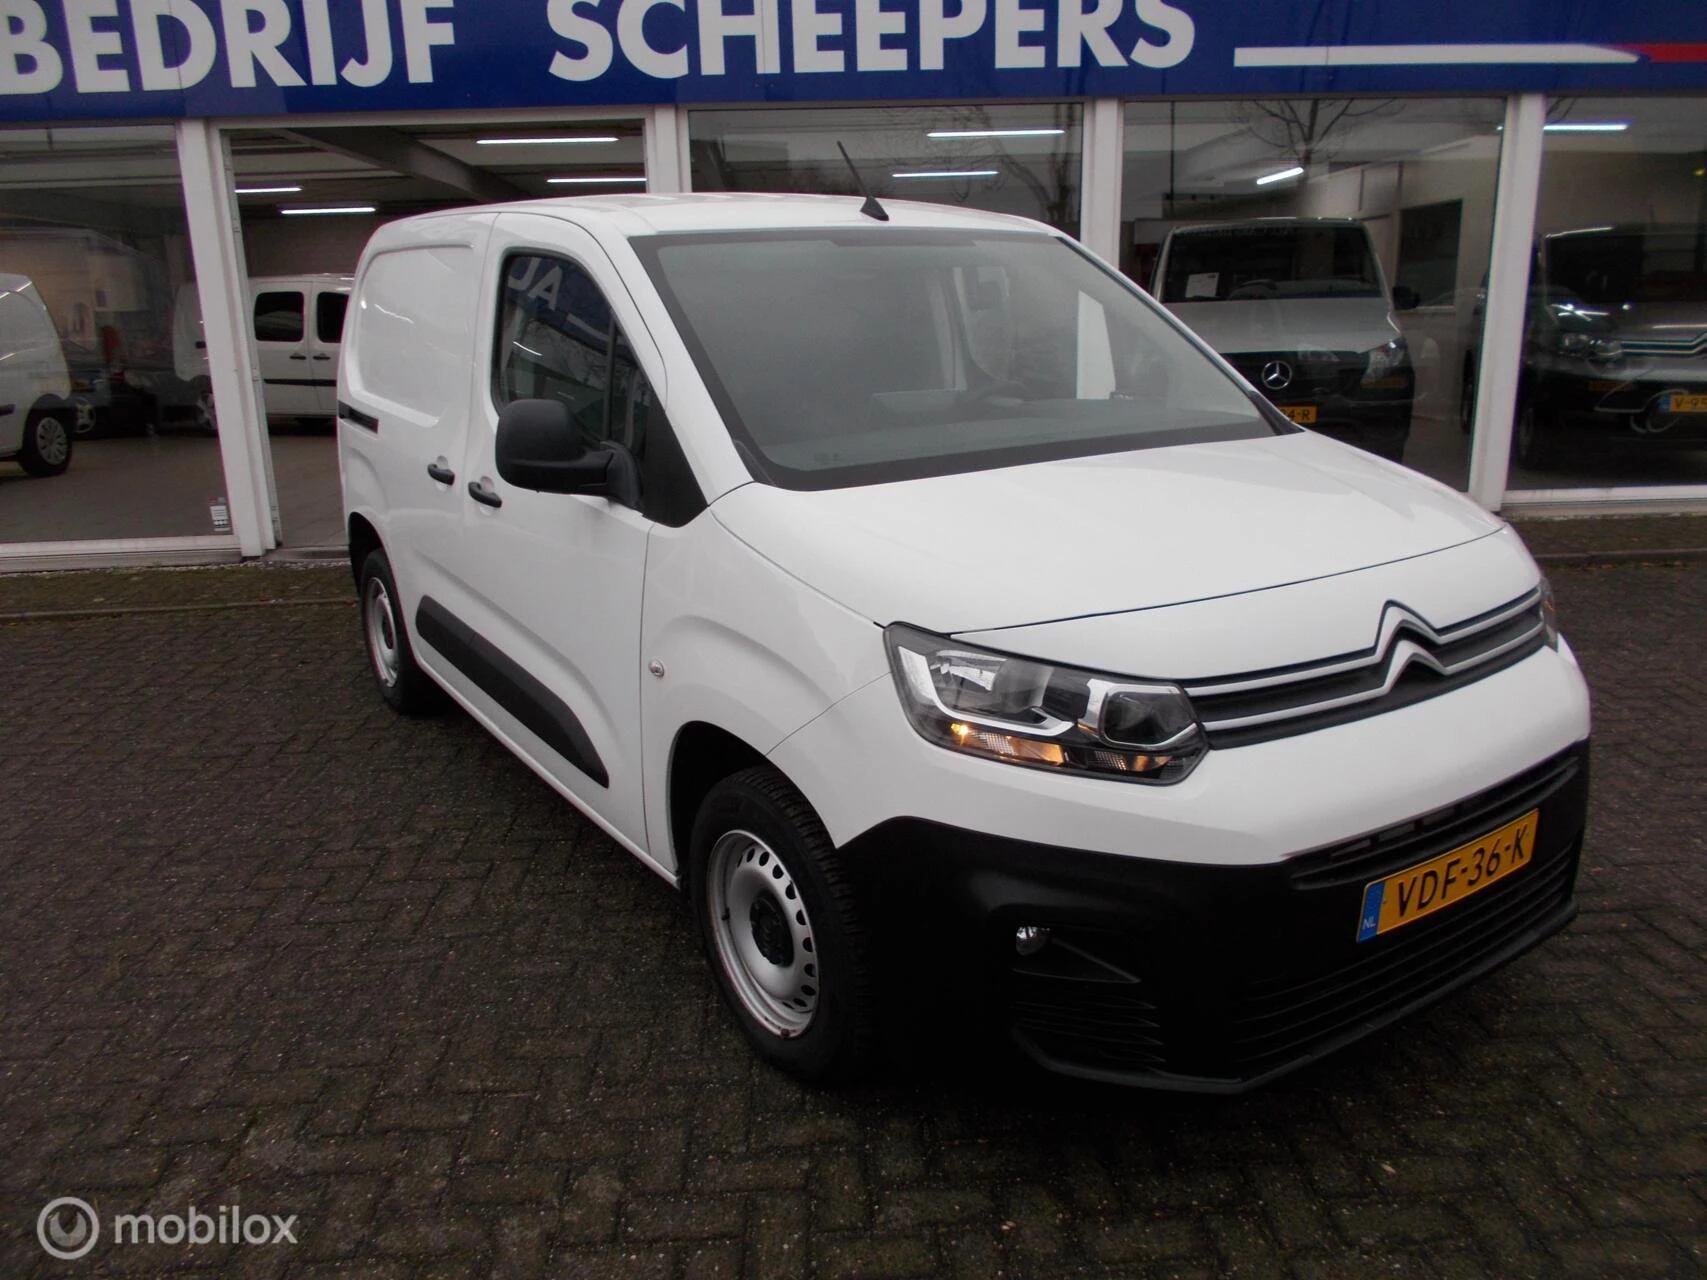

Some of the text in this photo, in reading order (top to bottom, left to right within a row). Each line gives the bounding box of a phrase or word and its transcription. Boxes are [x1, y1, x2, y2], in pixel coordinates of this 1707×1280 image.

[547, 0, 1195, 82] SCHEEPERS
[1361, 823, 1528, 930] NL VDF-36-K
